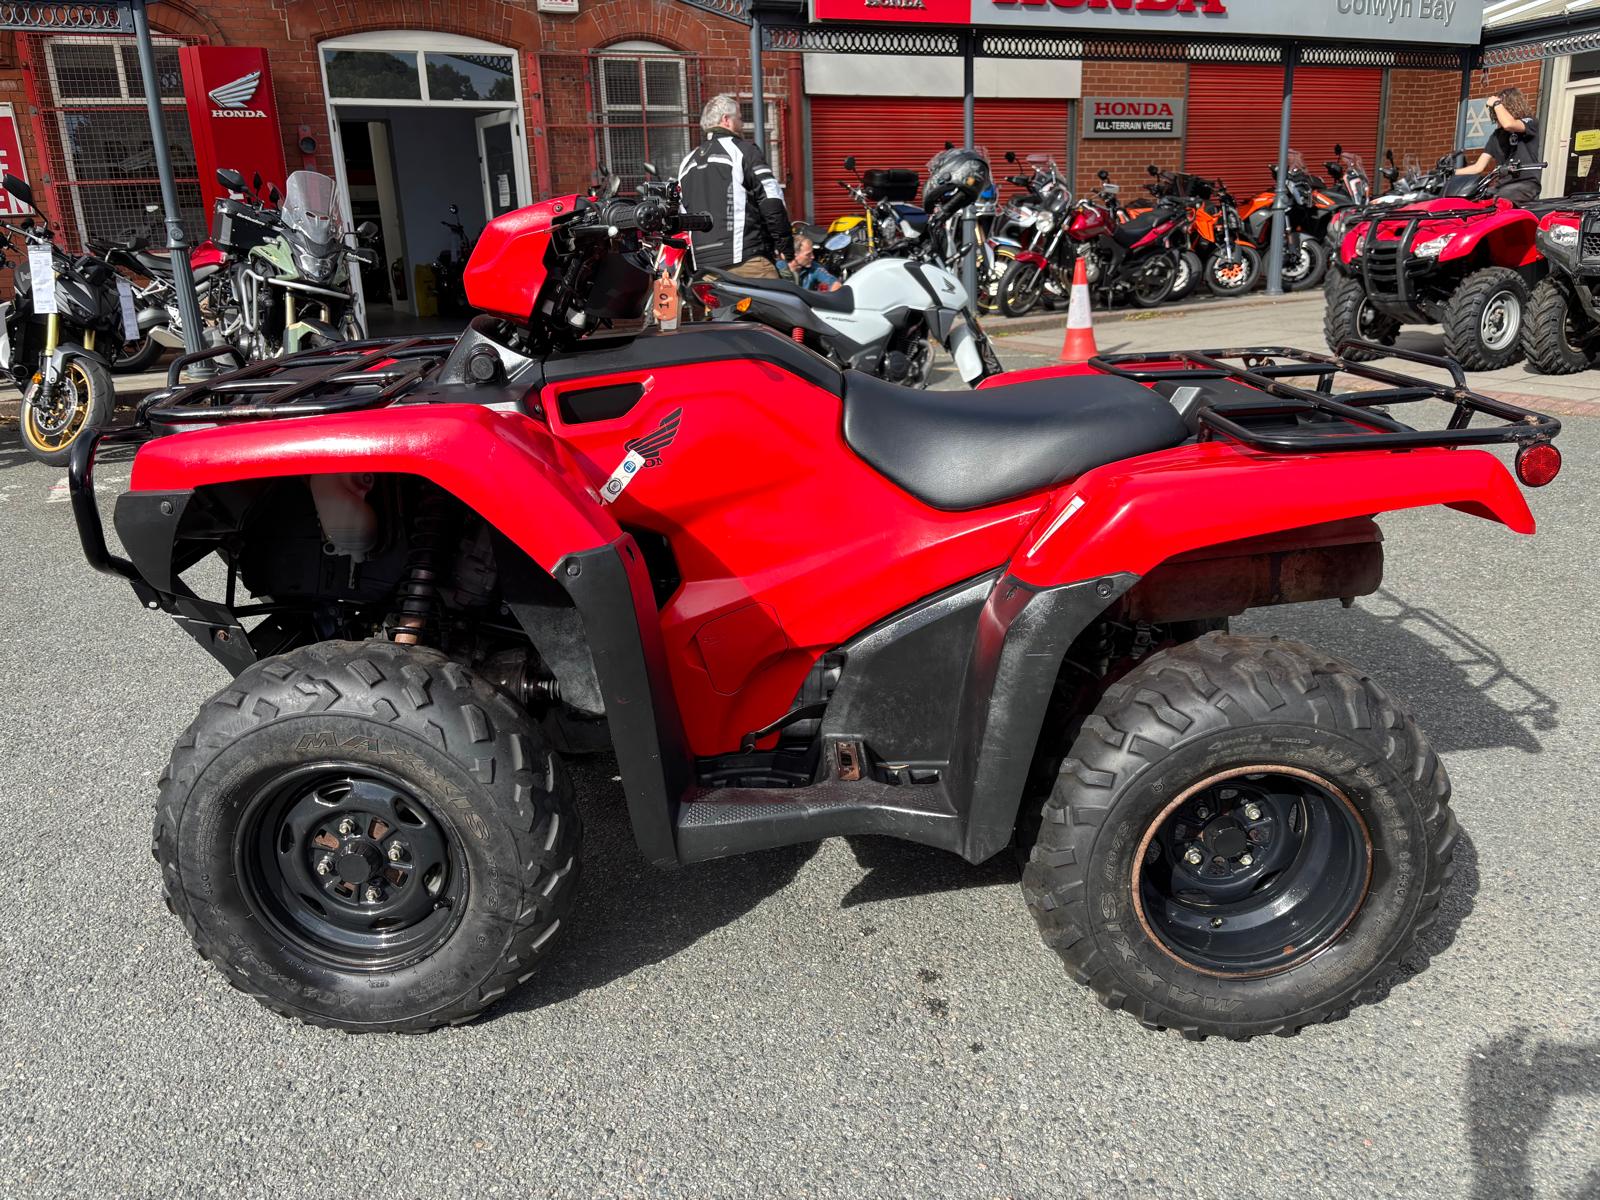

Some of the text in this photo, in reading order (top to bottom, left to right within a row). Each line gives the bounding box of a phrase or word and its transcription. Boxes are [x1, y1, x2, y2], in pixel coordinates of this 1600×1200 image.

[1336, 0, 1456, 27] Colwyn Bay
[211, 109, 268, 118] HONDA
[1094, 102, 1174, 116] HONDA
[1095, 121, 1172, 131] ALL-TERRAIN VEHICLE
[659, 293, 670, 309] 10
[295, 731, 490, 840] MAXXIS
[1101, 892, 1242, 1012] MAXXIS
